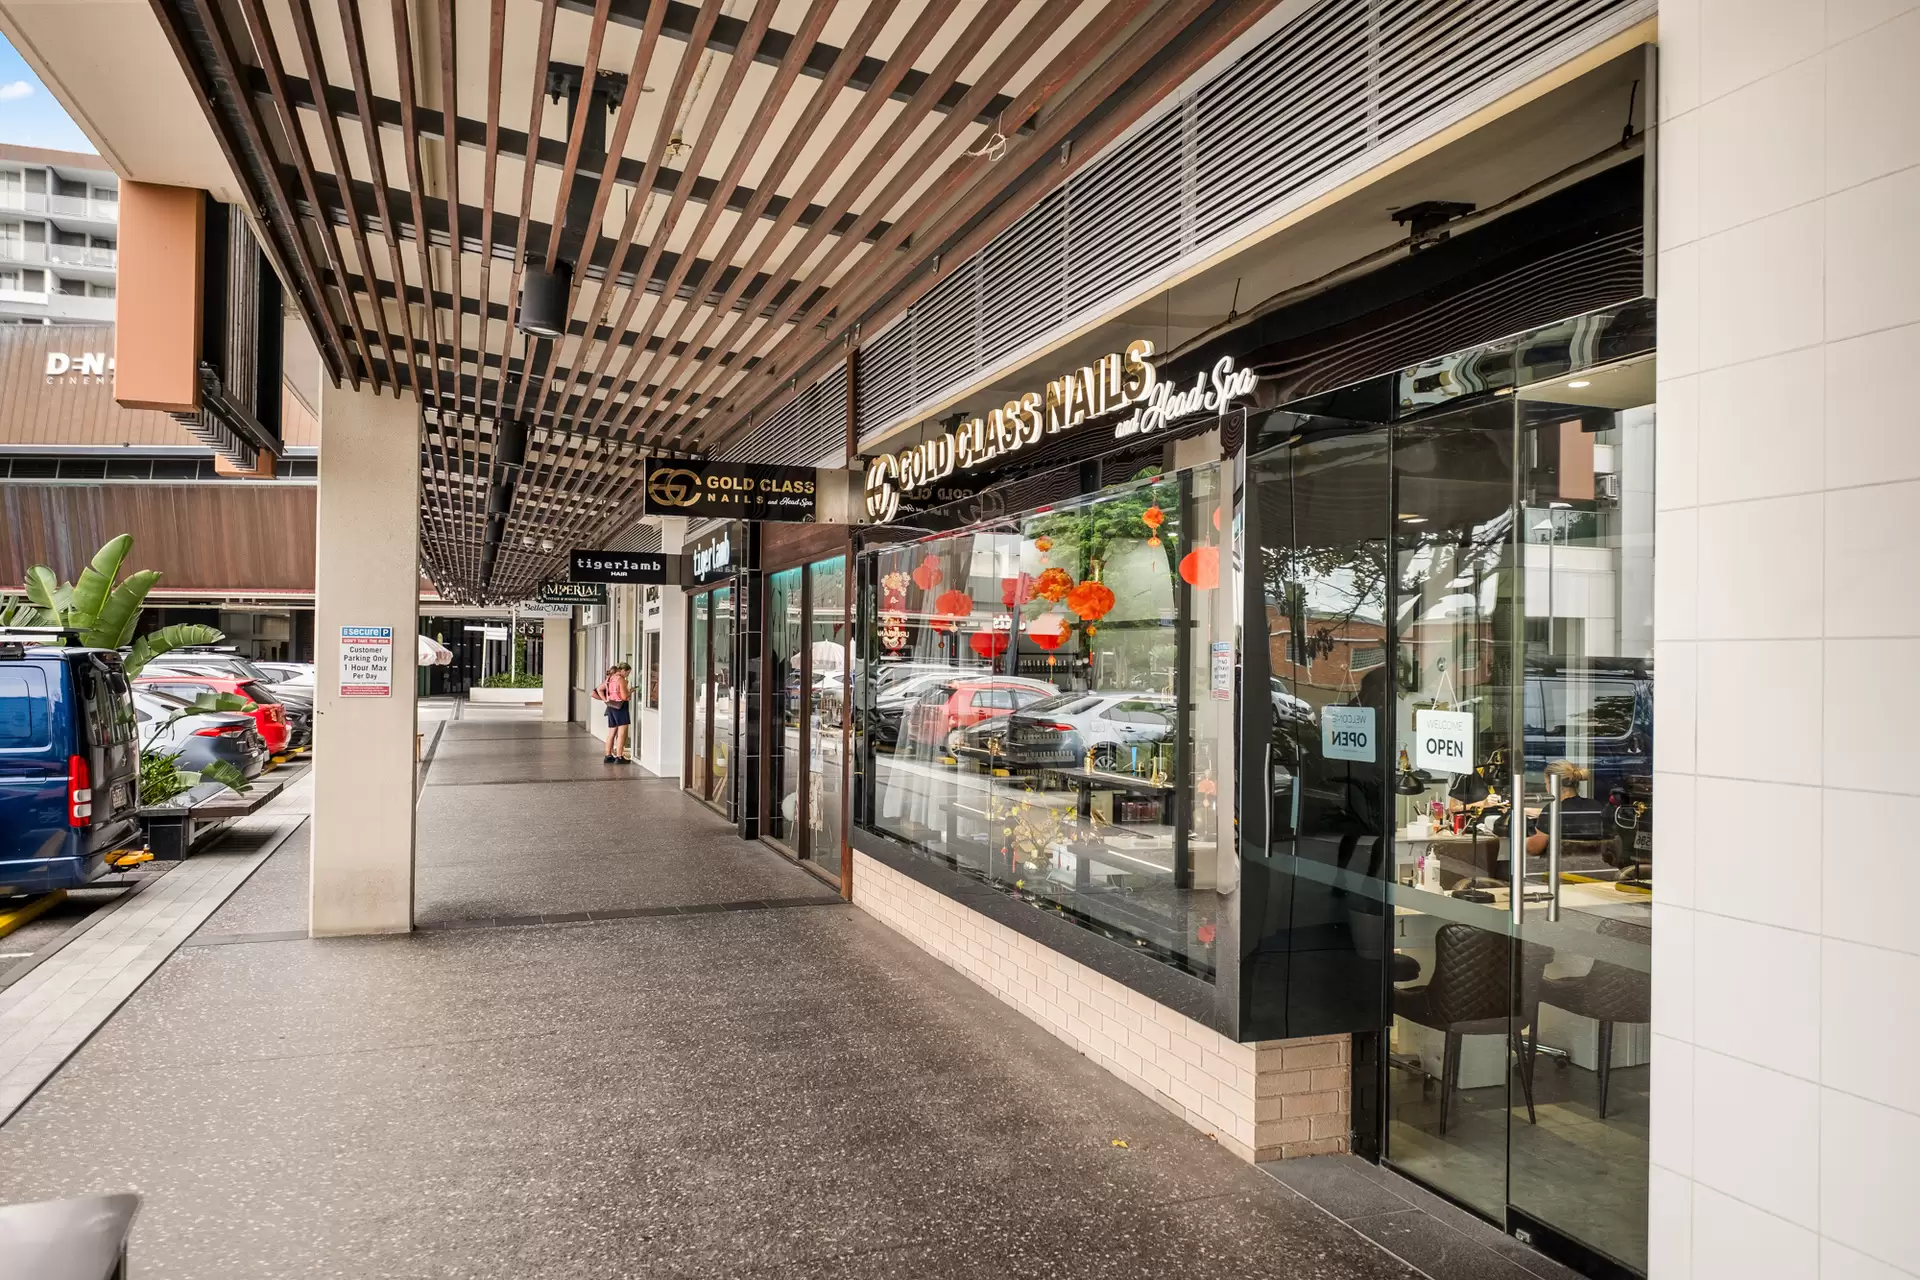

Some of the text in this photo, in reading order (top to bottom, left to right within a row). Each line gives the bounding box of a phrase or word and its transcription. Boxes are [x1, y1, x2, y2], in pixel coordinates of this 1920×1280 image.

[1115, 355, 1260, 438] and Head Spa
[899, 339, 1156, 491] GOLD CLASS NAILS
[706, 475, 815, 494] GOLD CLASS
[707, 493, 764, 504] NAILS
[799, 498, 813, 507] Spa
[577, 558, 661, 571] tigerlamb
[552, 604, 569, 612] Deli
[348, 628, 379, 636] secure
[343, 655, 388, 663] Parking Only
[1427, 719, 1463, 731] WELCOME
[1426, 738, 1463, 758] OPEN
[1408, 843, 1415, 856] 7
[1399, 918, 1406, 937] 1
